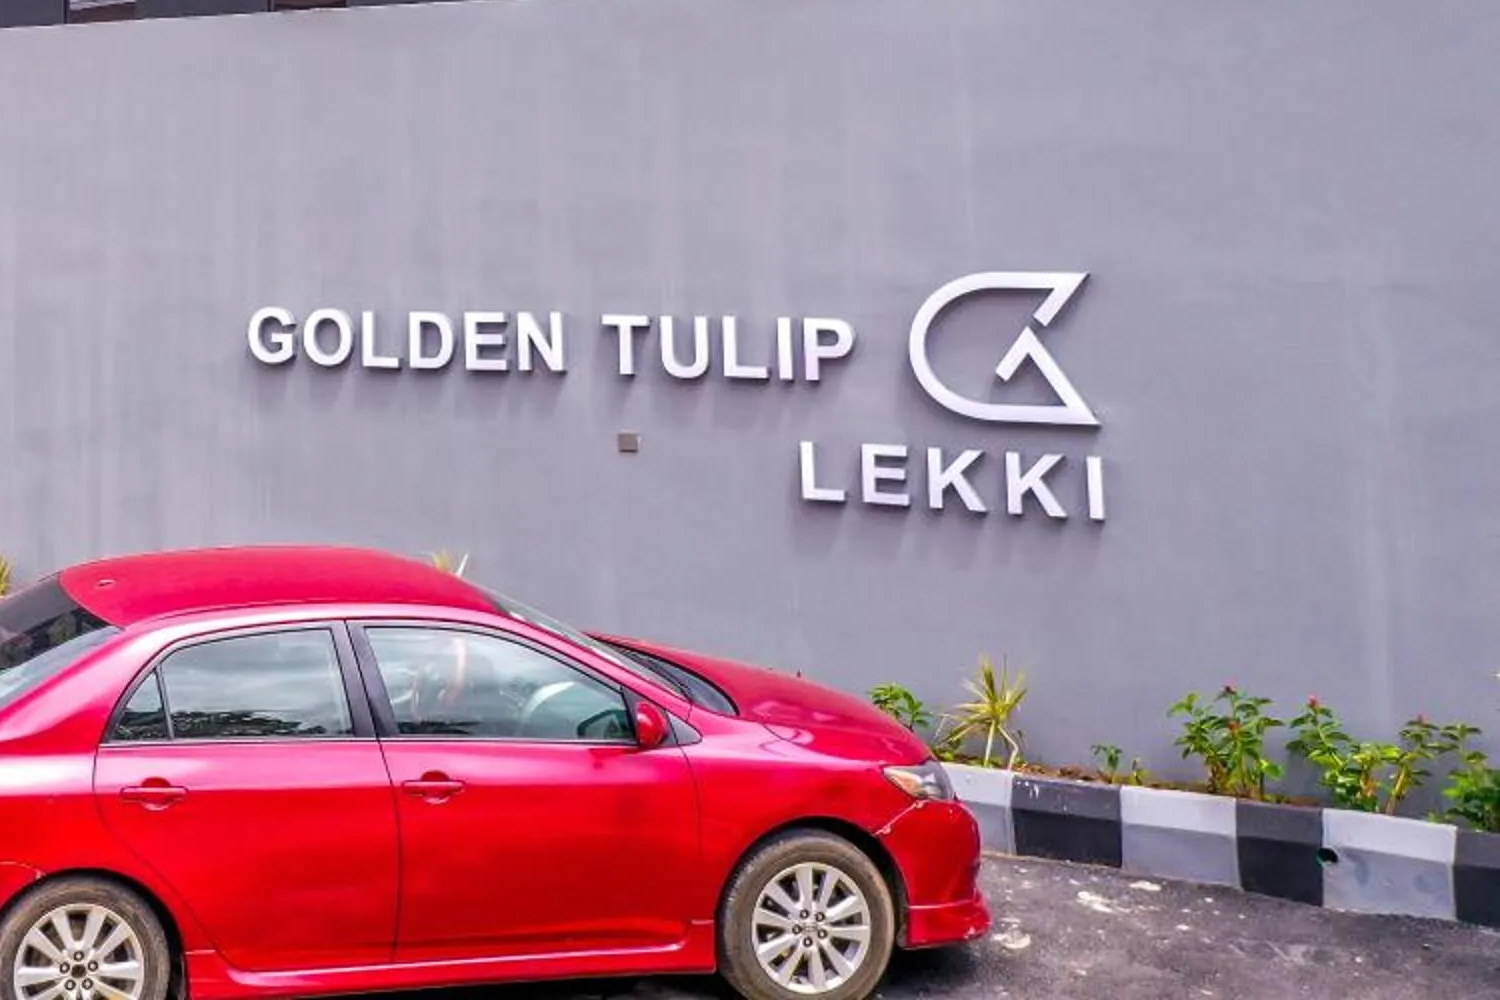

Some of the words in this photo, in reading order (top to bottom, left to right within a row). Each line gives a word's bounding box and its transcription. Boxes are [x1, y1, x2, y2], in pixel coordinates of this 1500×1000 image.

[248, 306, 567, 372] GOLDEN
[601, 314, 854, 381] TULIP
[800, 440, 1105, 521] LEKKI
